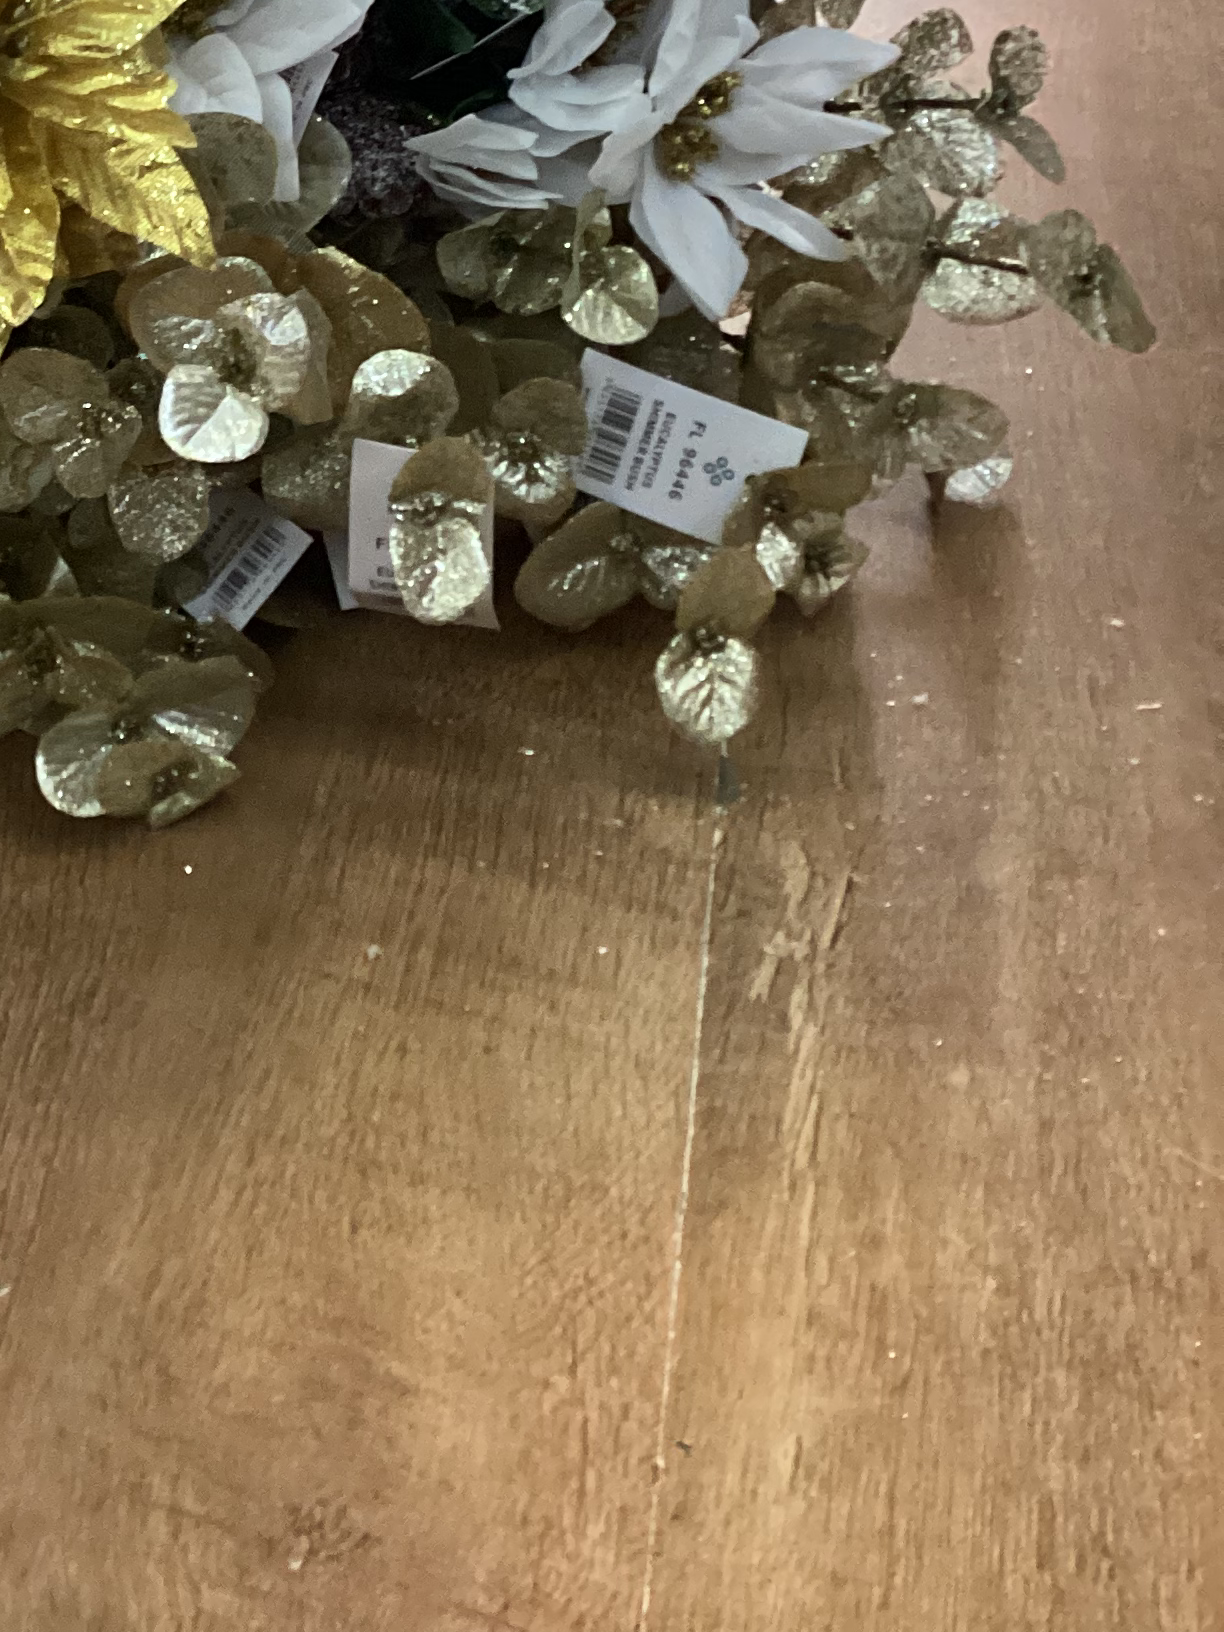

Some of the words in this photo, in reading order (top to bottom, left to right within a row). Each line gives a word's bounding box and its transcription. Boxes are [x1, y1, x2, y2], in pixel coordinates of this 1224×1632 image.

[636, 398, 665, 456] SHIMMER
[641, 411, 677, 489] EUCALYPTUS
[688, 419, 707, 439] FL
[624, 456, 645, 492] BUSH
[668, 447, 698, 501] 96446
